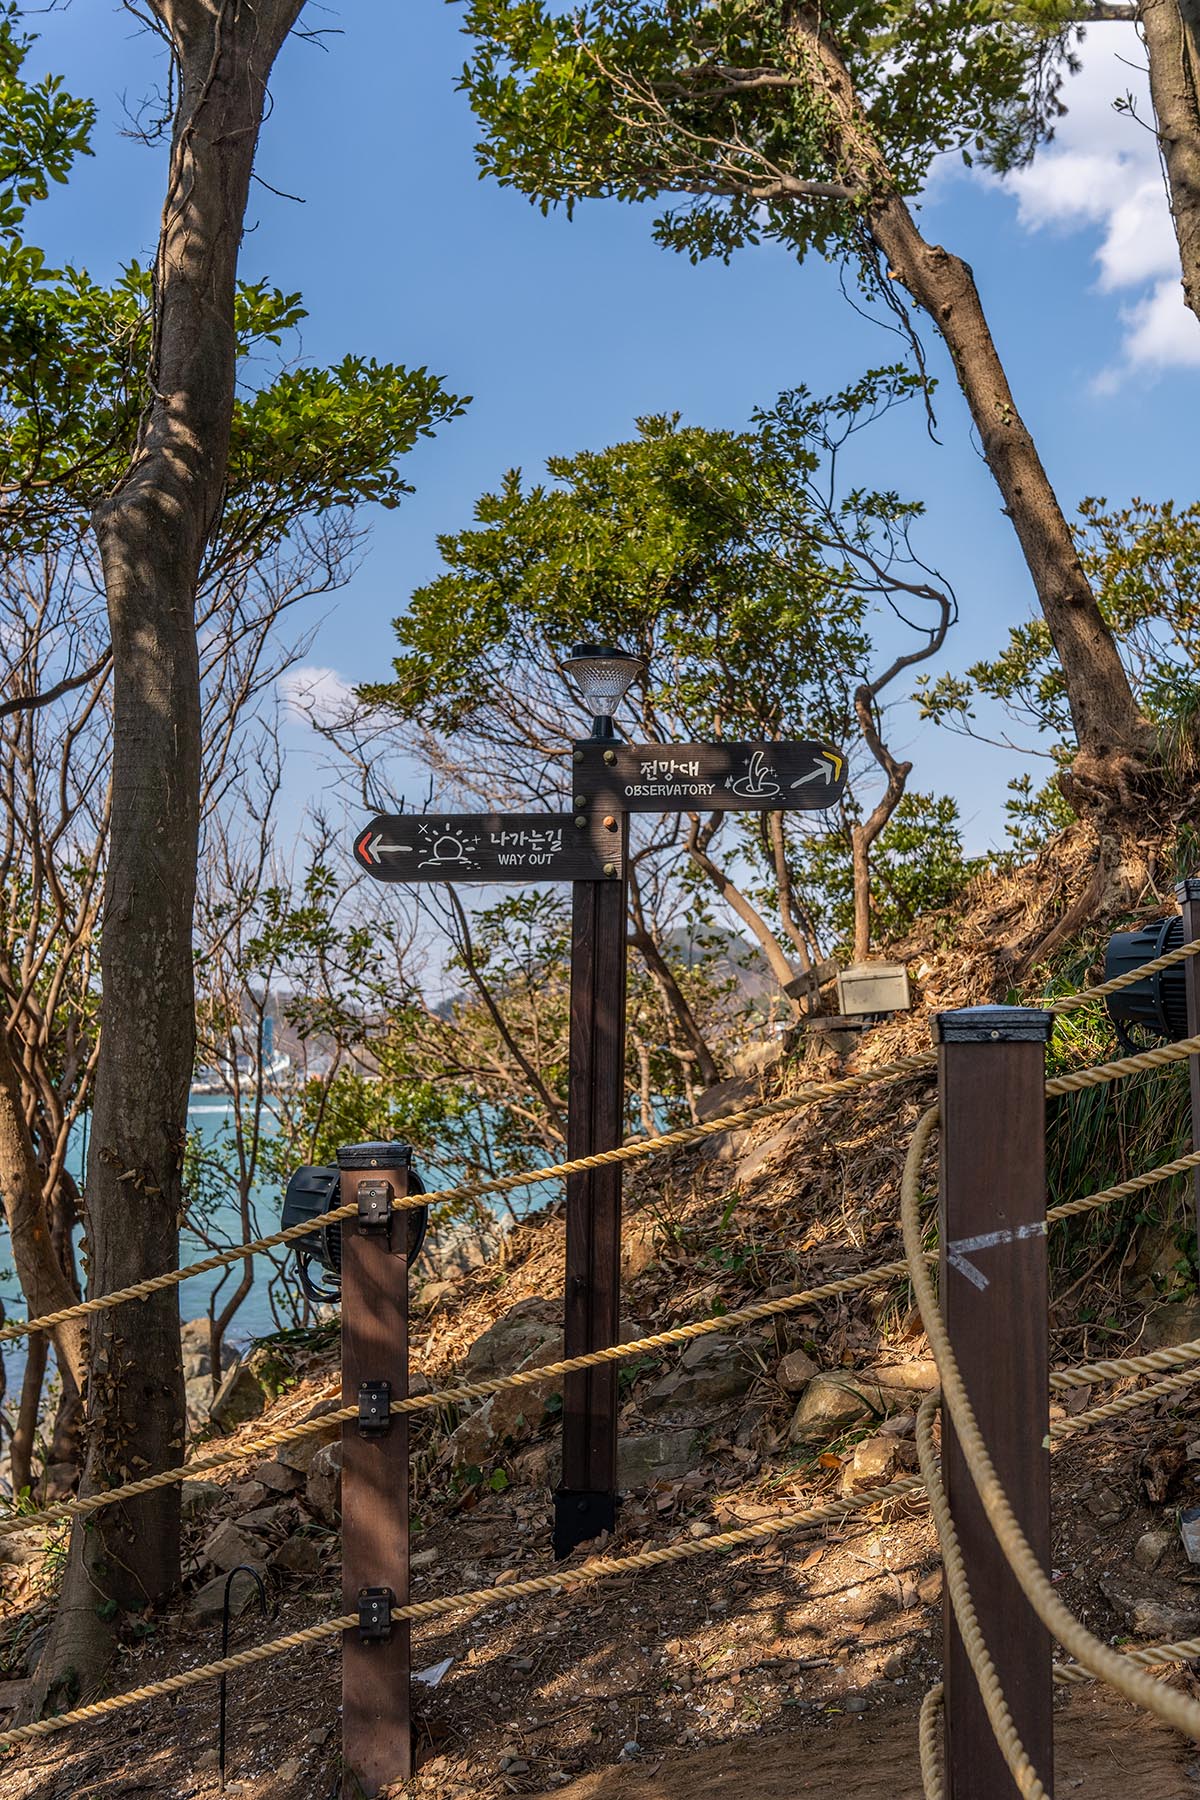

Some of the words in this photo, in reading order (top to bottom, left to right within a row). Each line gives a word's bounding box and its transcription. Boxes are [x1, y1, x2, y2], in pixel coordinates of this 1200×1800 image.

[640, 759, 700, 781] 전망대
[624, 783, 716, 797] OBSERVATORY
[498, 853, 527, 866] WAY
[528, 853, 554, 866] OUT
